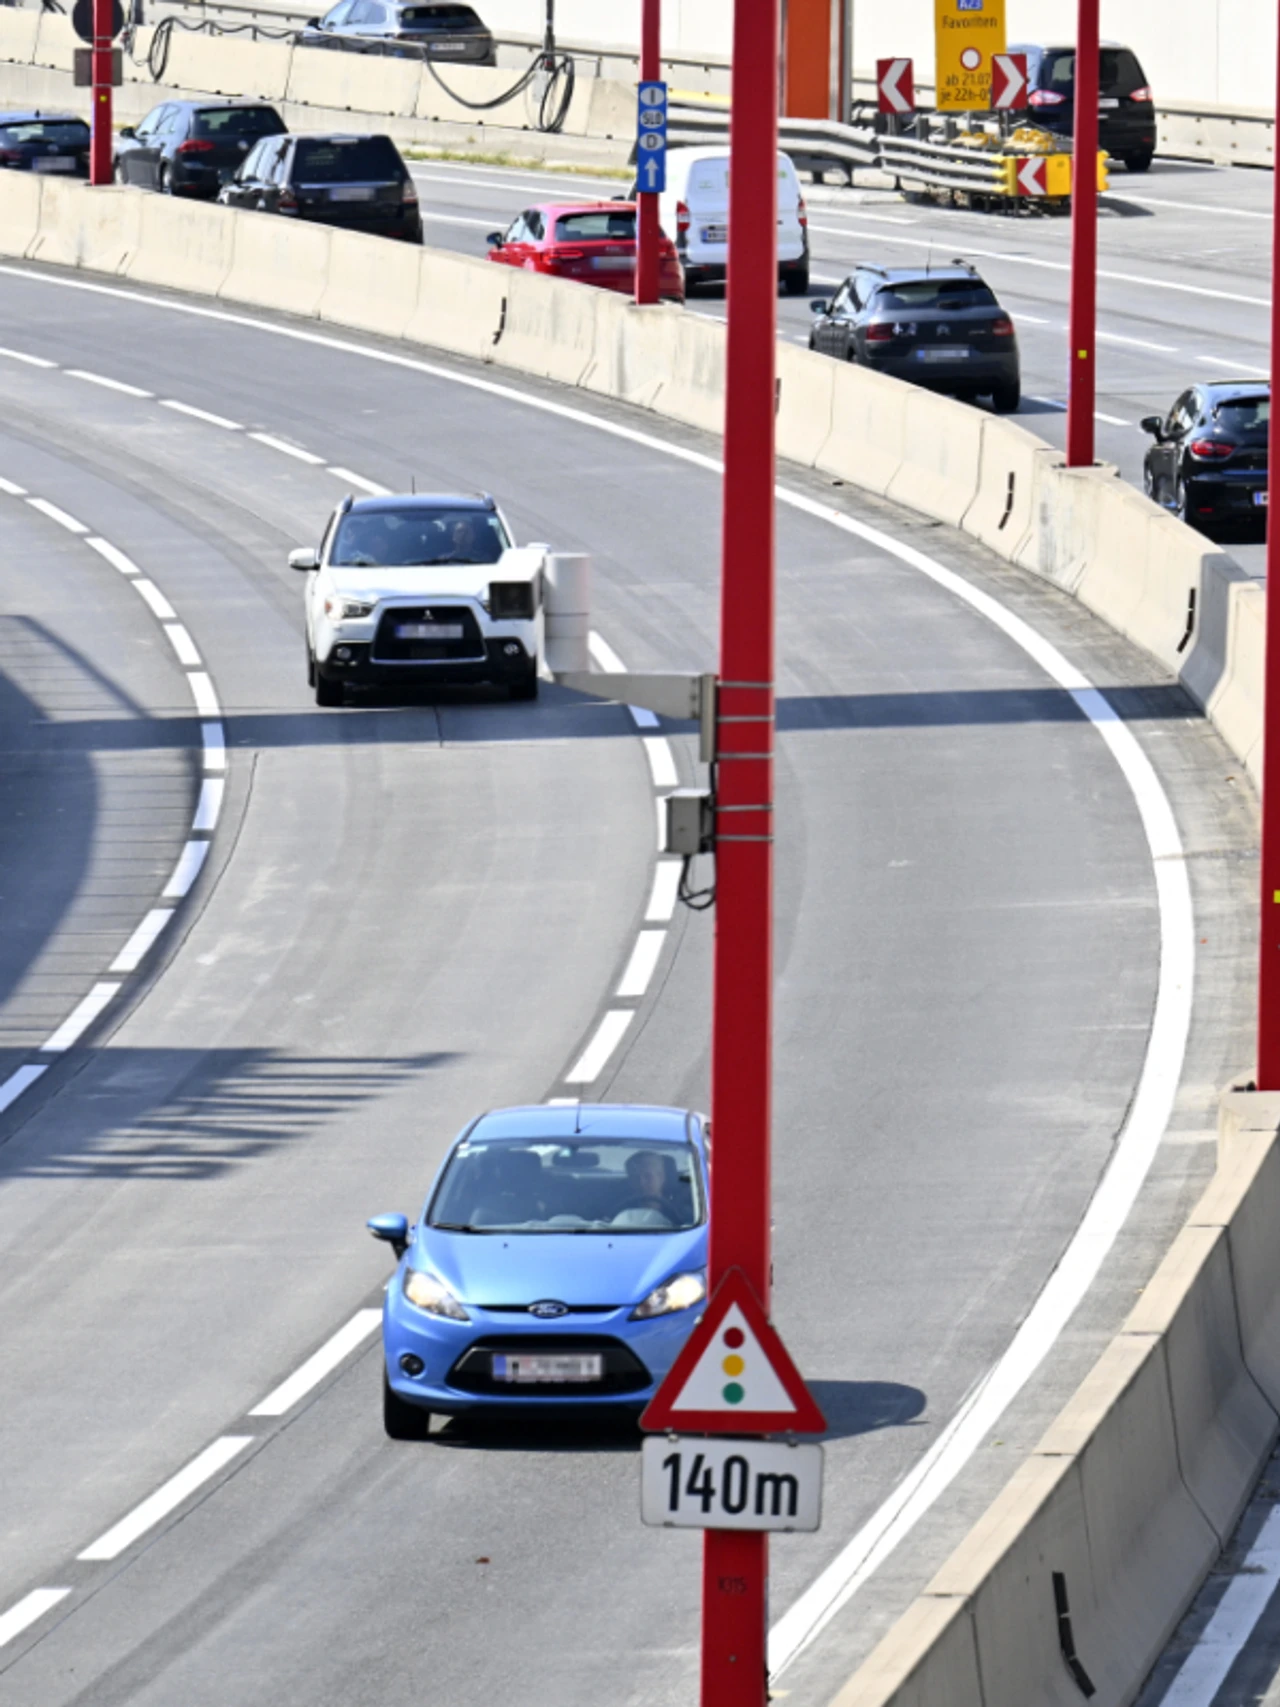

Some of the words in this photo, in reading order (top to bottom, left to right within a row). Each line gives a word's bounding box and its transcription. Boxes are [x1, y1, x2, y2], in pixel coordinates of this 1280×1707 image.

[942, 15, 998, 29] Favoriten
[945, 74, 959, 86] ab
[940, 88, 950, 104] je
[954, 88, 990, 101] 22h-0
[646, 134, 658, 149] D
[662, 1453, 799, 1517] 140m
